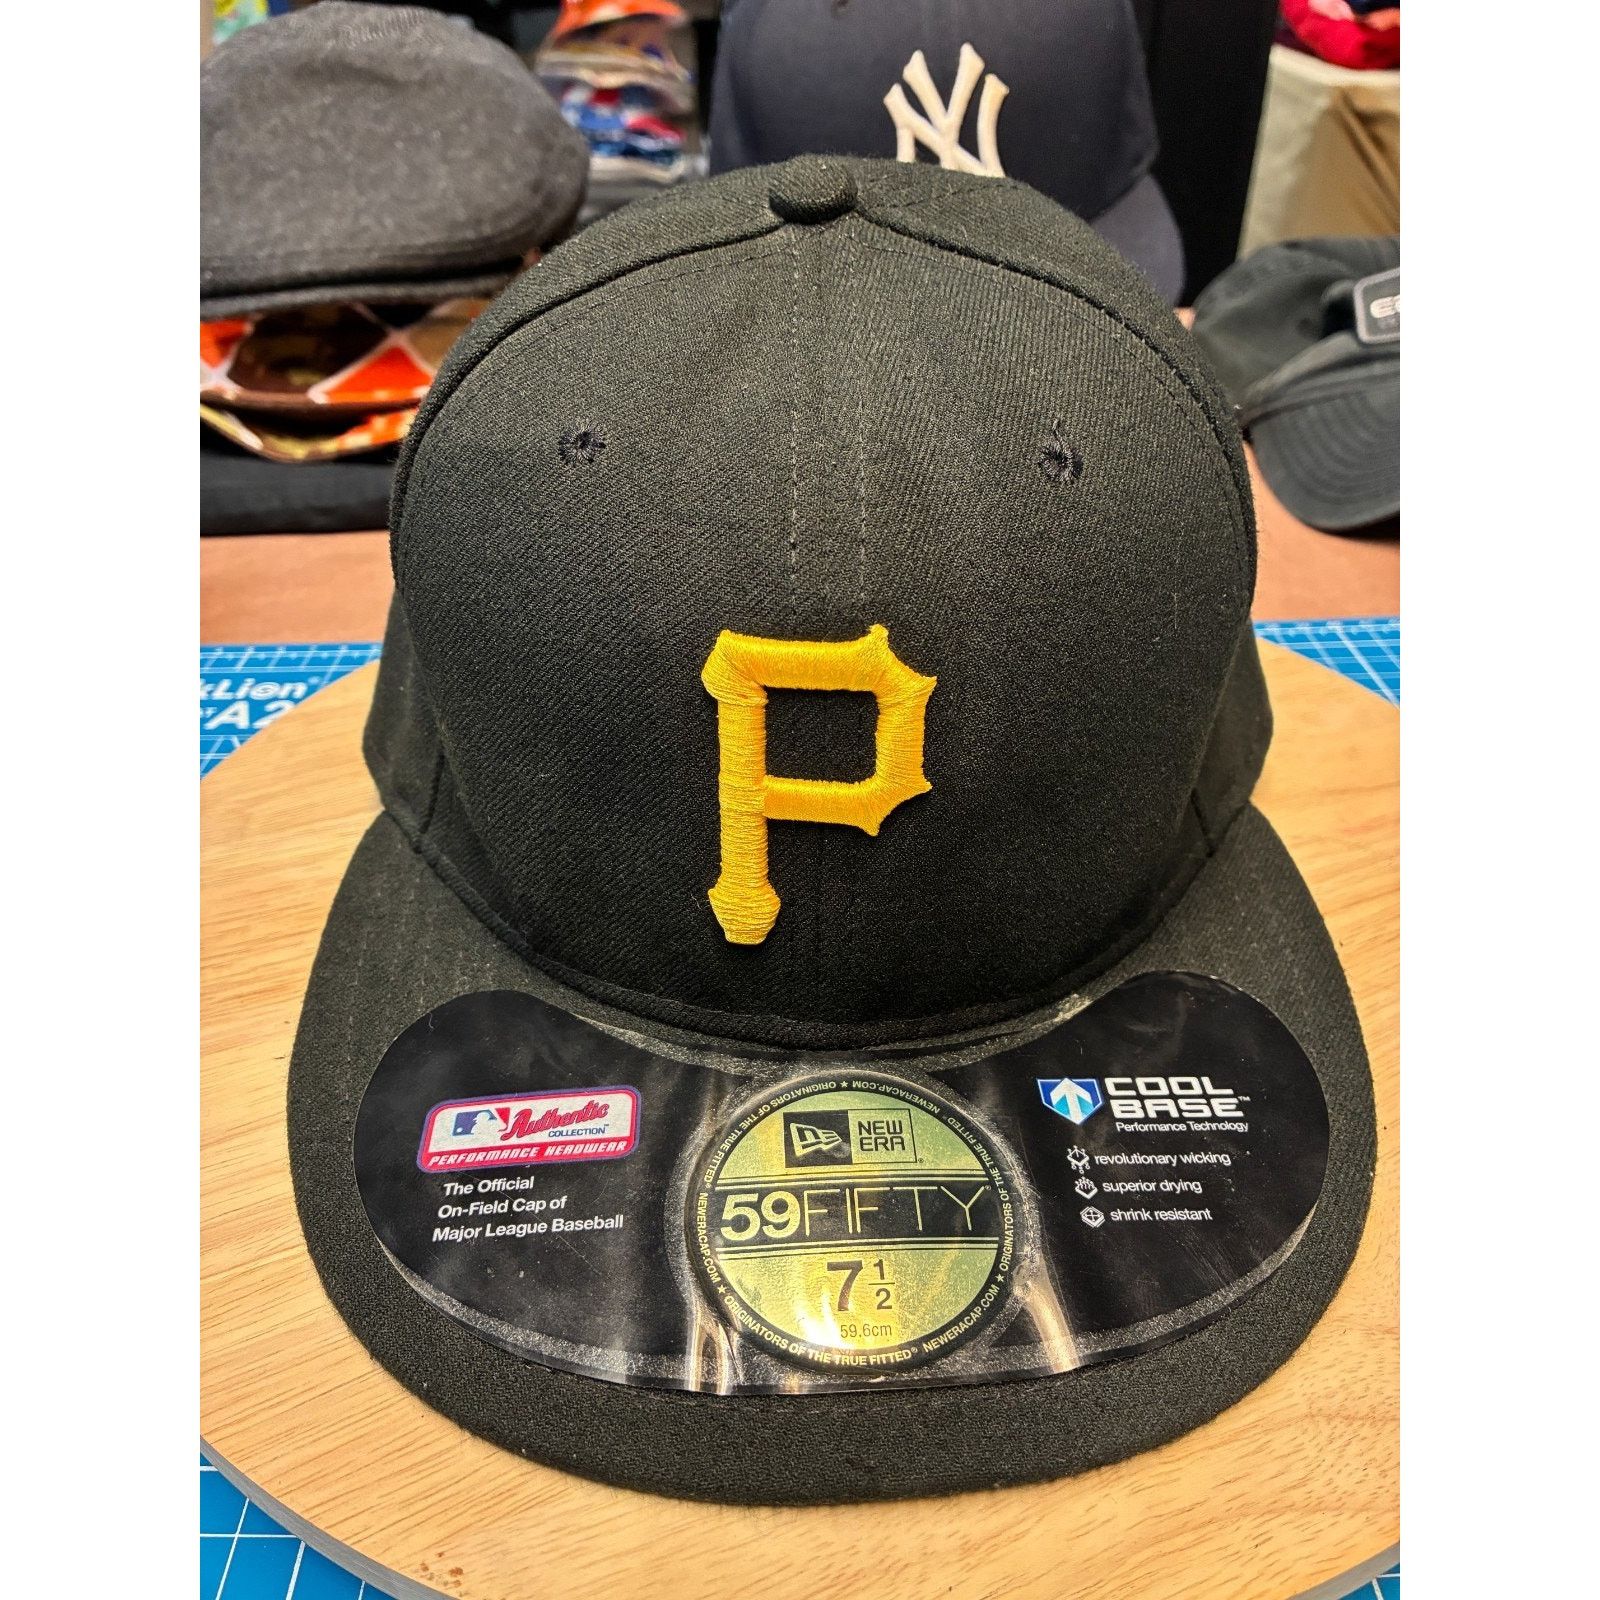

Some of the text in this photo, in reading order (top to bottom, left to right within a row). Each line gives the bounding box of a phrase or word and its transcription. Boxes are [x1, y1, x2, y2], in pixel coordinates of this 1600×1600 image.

[883, 42, 1010, 177] NY
[701, 624, 937, 944] P
[770, 1081, 837, 1107] ORIGINATORS
[852, 1080, 941, 1114] NEWERACAP.COM
[1104, 1076, 1234, 1096] COOL
[500, 1100, 610, 1141] Authentic
[738, 1113, 759, 1130] THE
[757, 1104, 771, 1117] OF
[857, 1120, 904, 1136] NEW
[1115, 1121, 1249, 1133] Performance Technology
[720, 1129, 742, 1152] TRUE
[859, 1136, 906, 1152] ERA
[428, 1140, 628, 1167] PERFORMANCE HEADWEAR
[973, 1143, 994, 1170] TRUE
[1094, 1151, 1232, 1167] revolutionary wicking
[443, 1176, 535, 1197] The Official
[988, 1168, 1006, 1188] THE
[1102, 1179, 1202, 1194] superior drying
[998, 1187, 1010, 1201] OF
[438, 1196, 568, 1219] On-Field Cap of
[1110, 1207, 1213, 1221] shrink resistant
[432, 1214, 624, 1244] Major League Baseball
[696, 1192, 722, 1284] NEWERACAP.COM
[999, 1202, 1015, 1272] ORIGINATORS
[724, 1295, 790, 1349] ORIGINATORS
[788, 1342, 807, 1356] OF
[806, 1349, 832, 1364] THE
[834, 1353, 868, 1366] TRUE
[922, 1284, 1001, 1353] NEWERACAP.COM
[840, 1324, 893, 1339] 59.6cm
